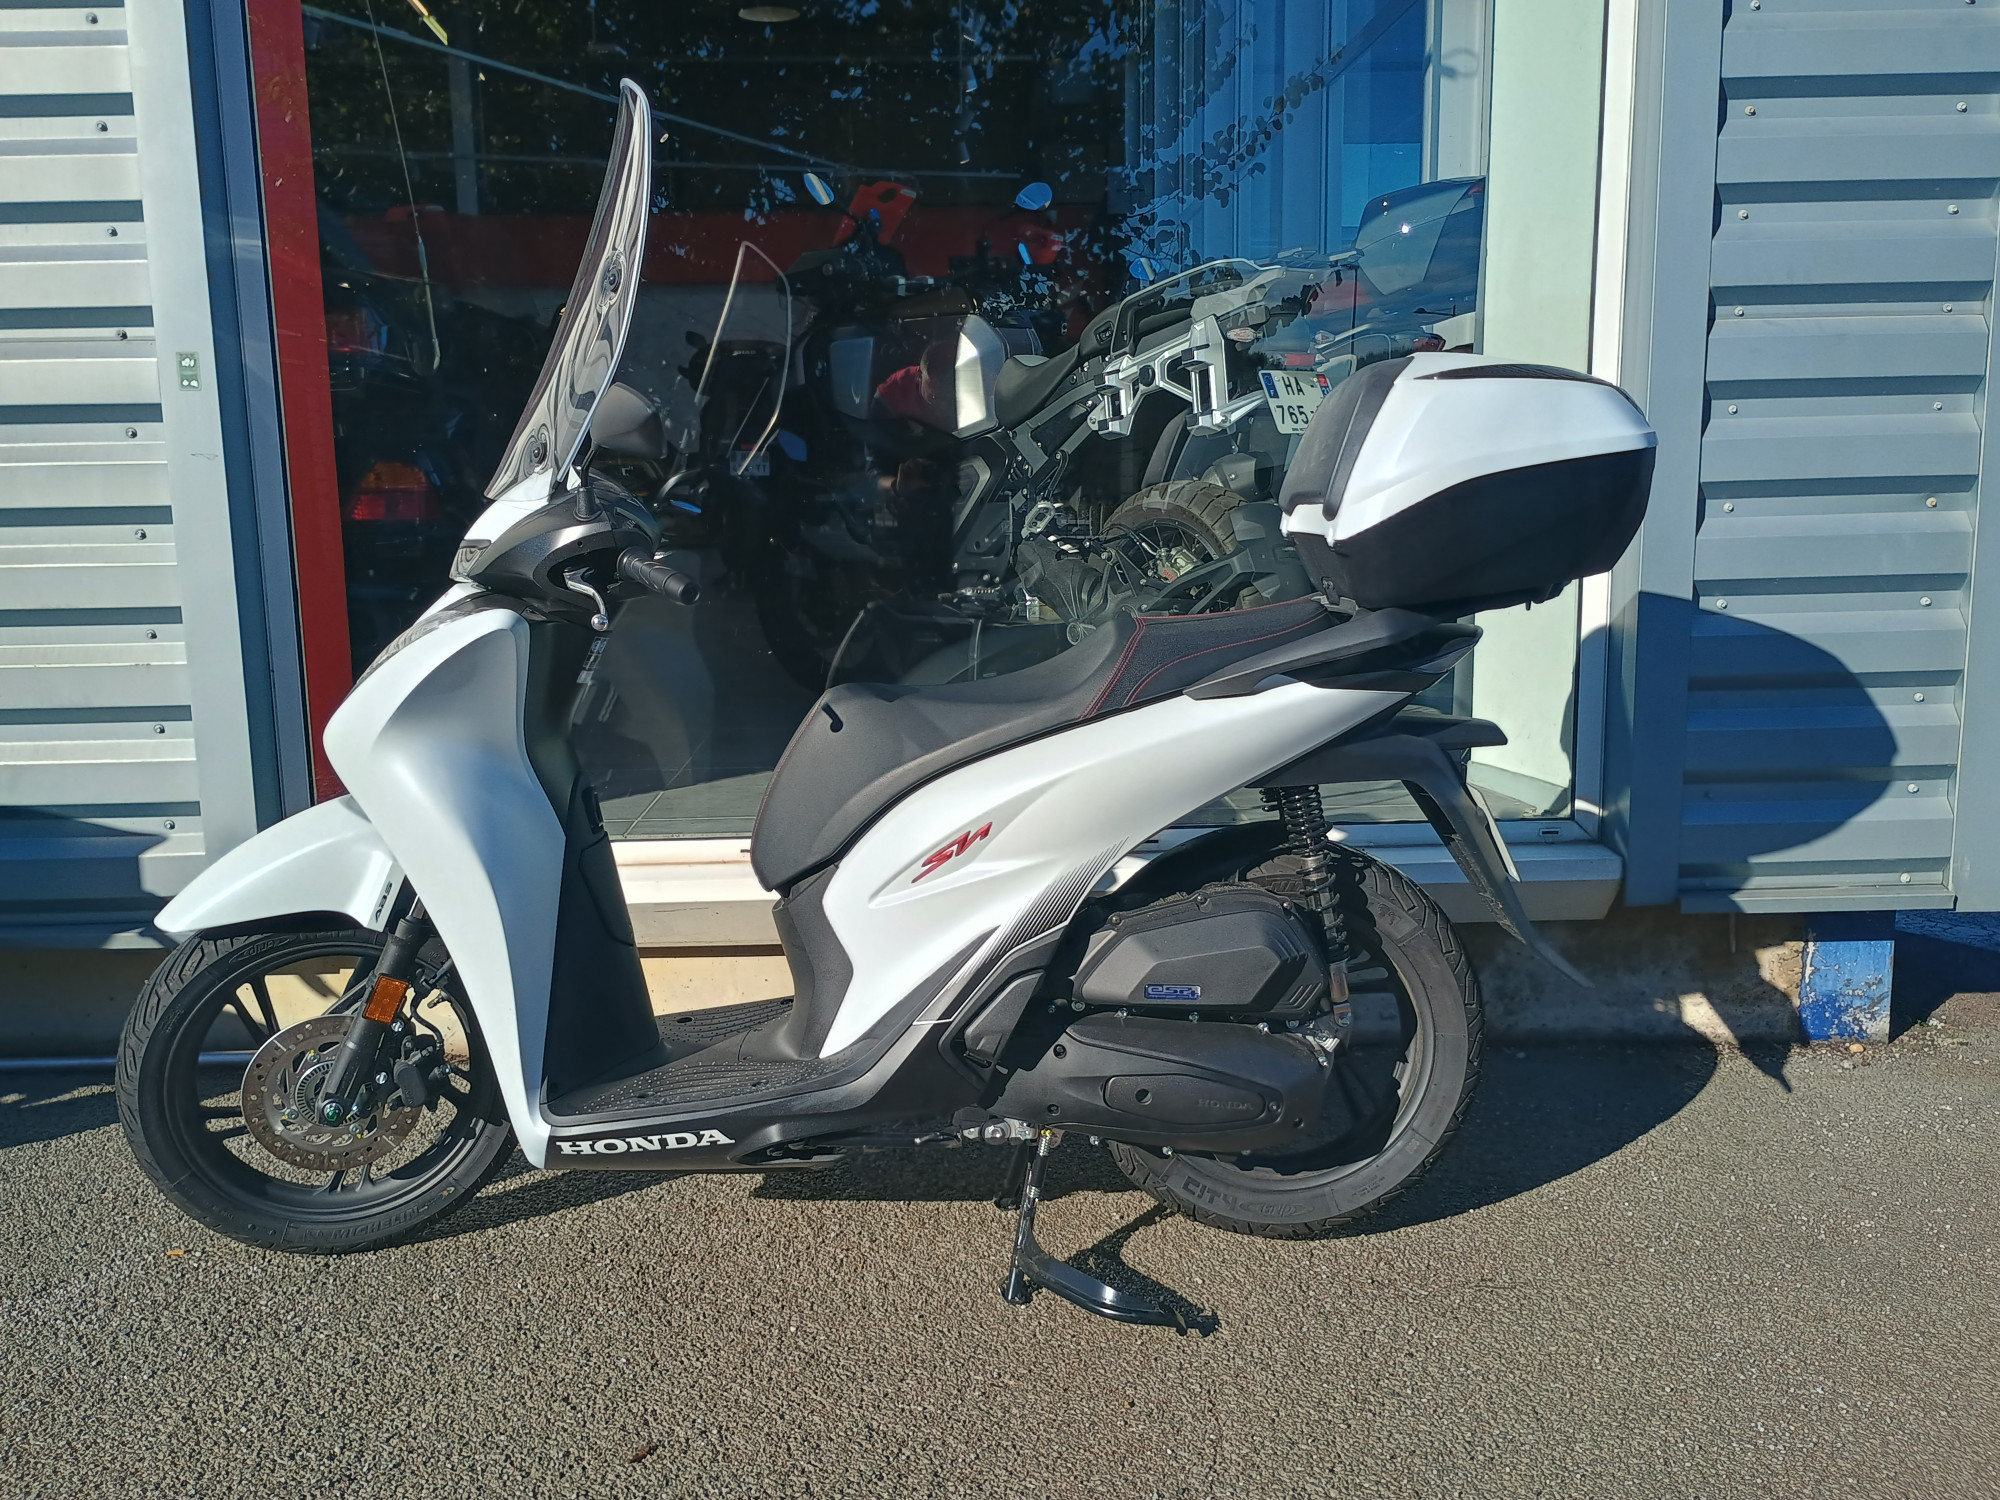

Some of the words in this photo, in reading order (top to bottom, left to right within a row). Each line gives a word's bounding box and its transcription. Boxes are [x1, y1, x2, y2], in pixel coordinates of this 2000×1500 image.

[556, 1128, 736, 1156] HONDA
[1182, 1175, 1238, 1210] CITY
[331, 1206, 420, 1240] MICHELIN
